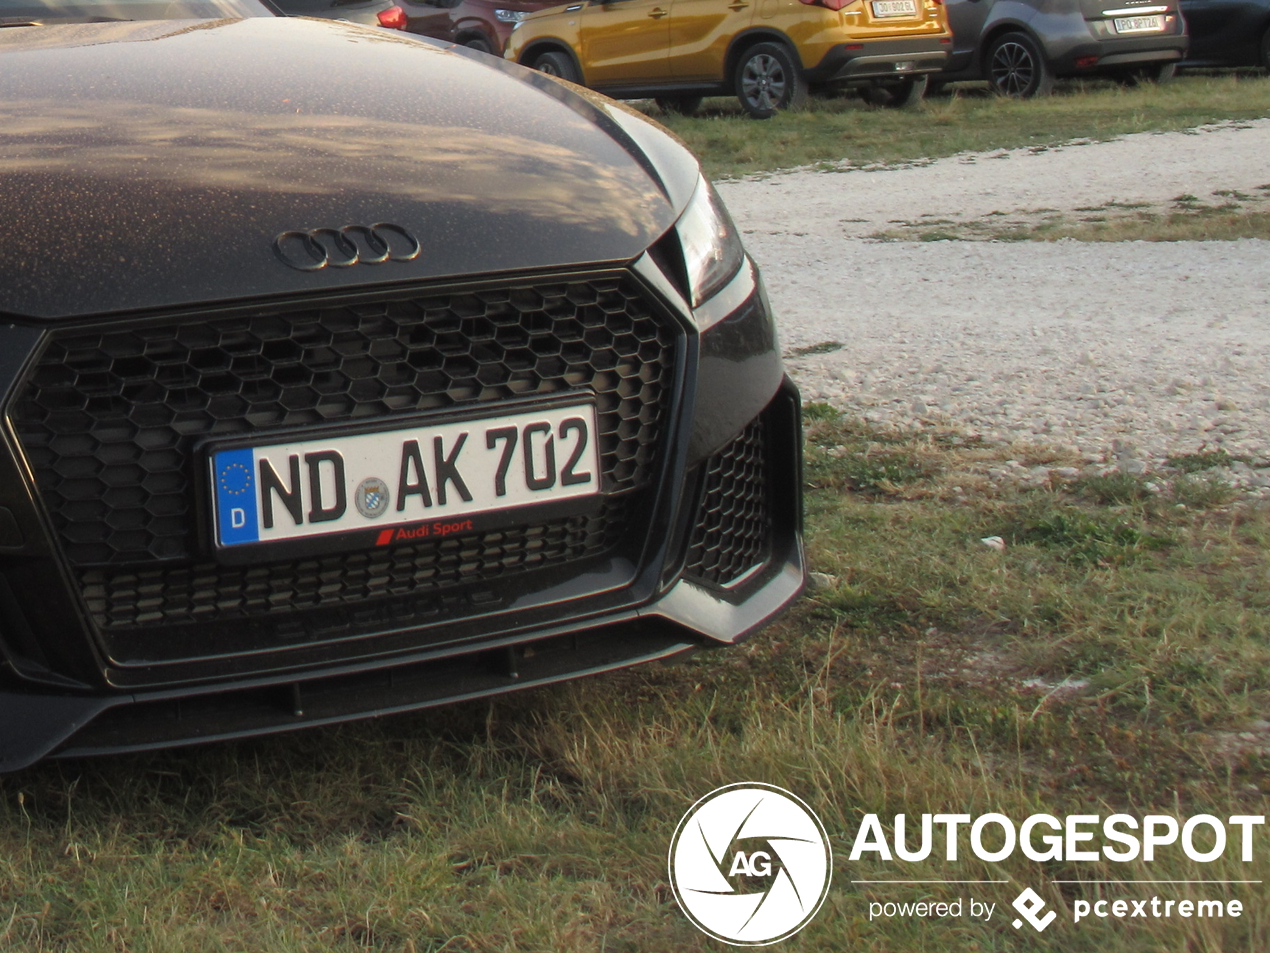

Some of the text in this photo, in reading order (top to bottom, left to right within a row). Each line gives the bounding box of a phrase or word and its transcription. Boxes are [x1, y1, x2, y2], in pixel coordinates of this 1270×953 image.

[231, 507, 247, 529] D
[258, 449, 347, 529] ND
[395, 430, 474, 512] AK
[485, 415, 592, 497] 702
[395, 518, 473, 541] Audi Sport
